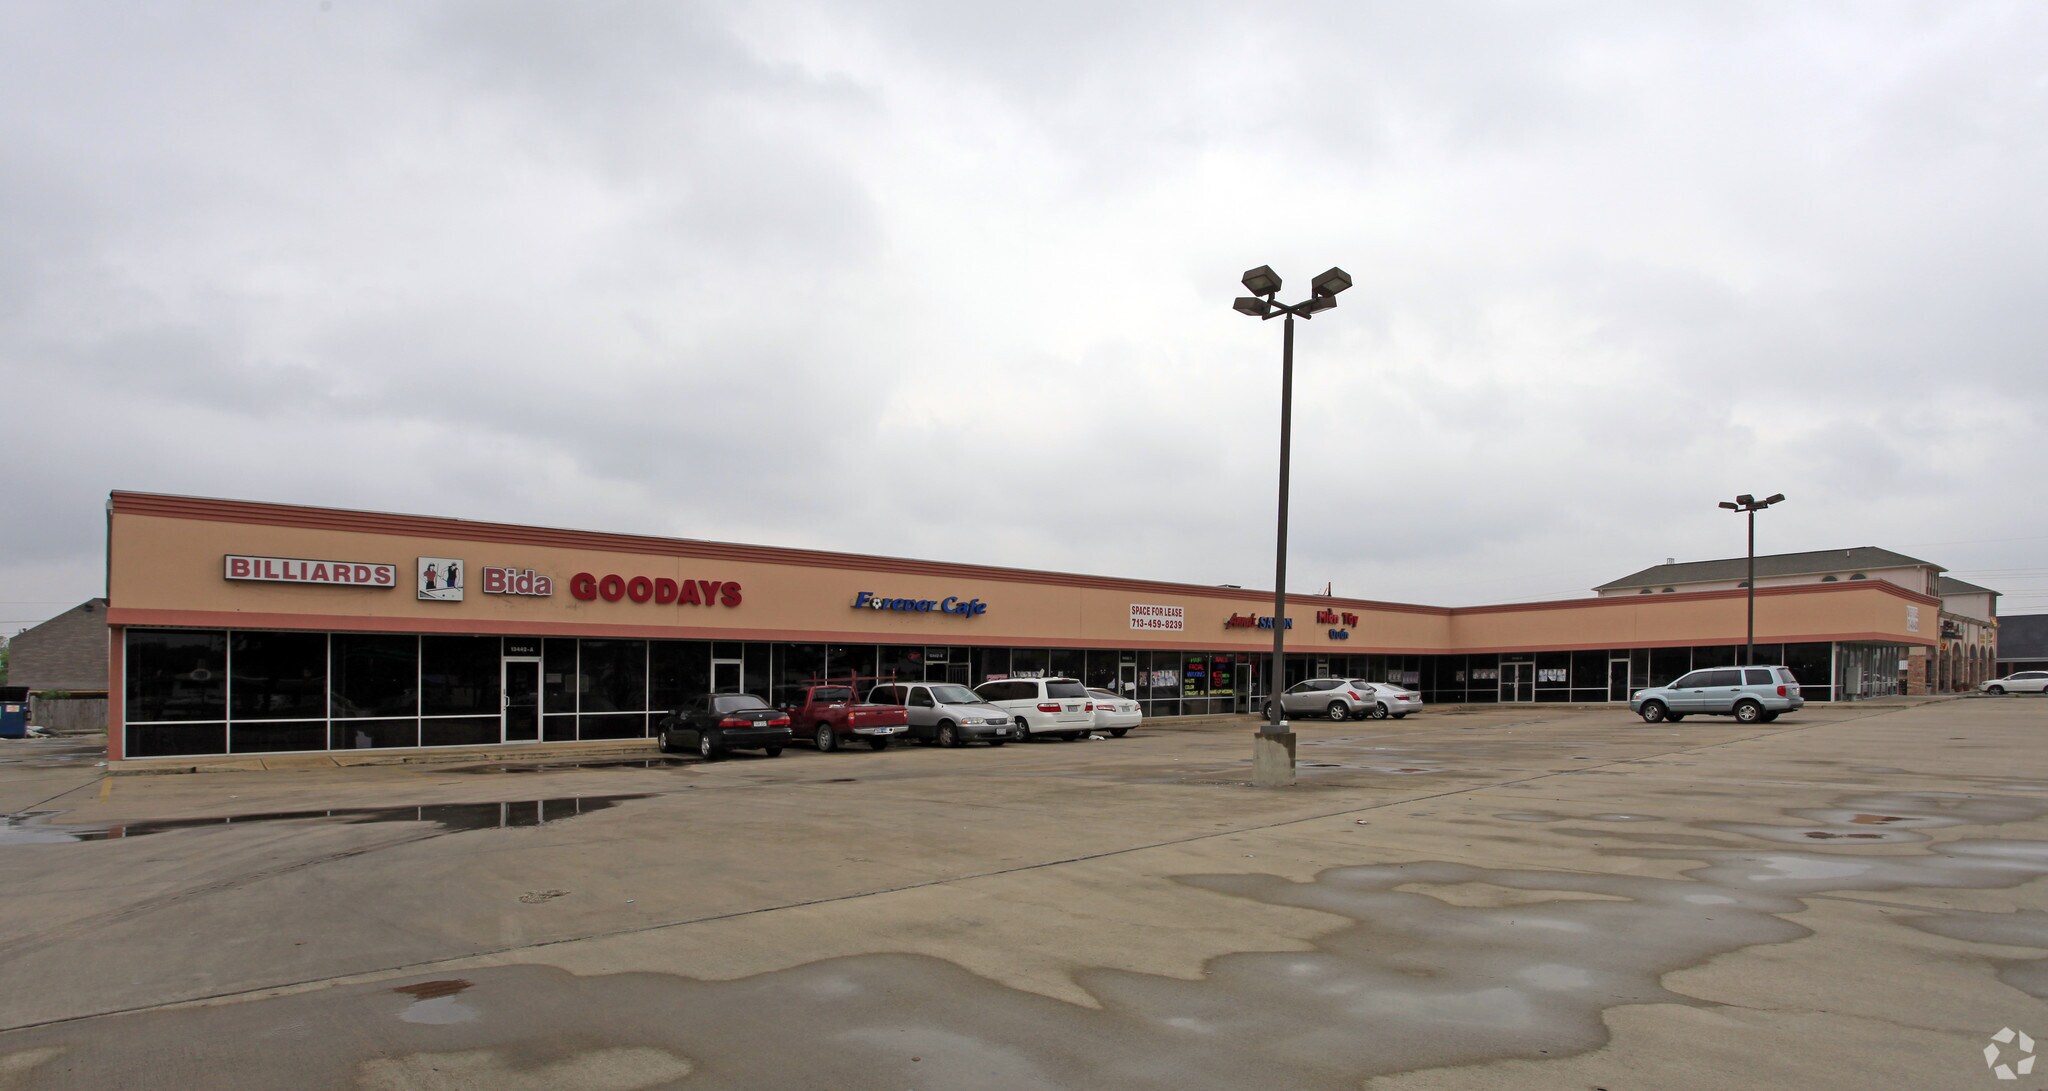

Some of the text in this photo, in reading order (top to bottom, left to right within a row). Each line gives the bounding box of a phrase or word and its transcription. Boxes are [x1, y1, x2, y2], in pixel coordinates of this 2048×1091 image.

[230, 558, 391, 584] BILLIARDS
[484, 567, 552, 596] Bida
[570, 572, 742, 607] GOODAYS
[941, 596, 987, 618] Cafe
[1132, 605, 1183, 618] SPACE FOR LEASE
[1132, 618, 1183, 629] 713-459-8239
[1258, 616, 1293, 629] SAN
